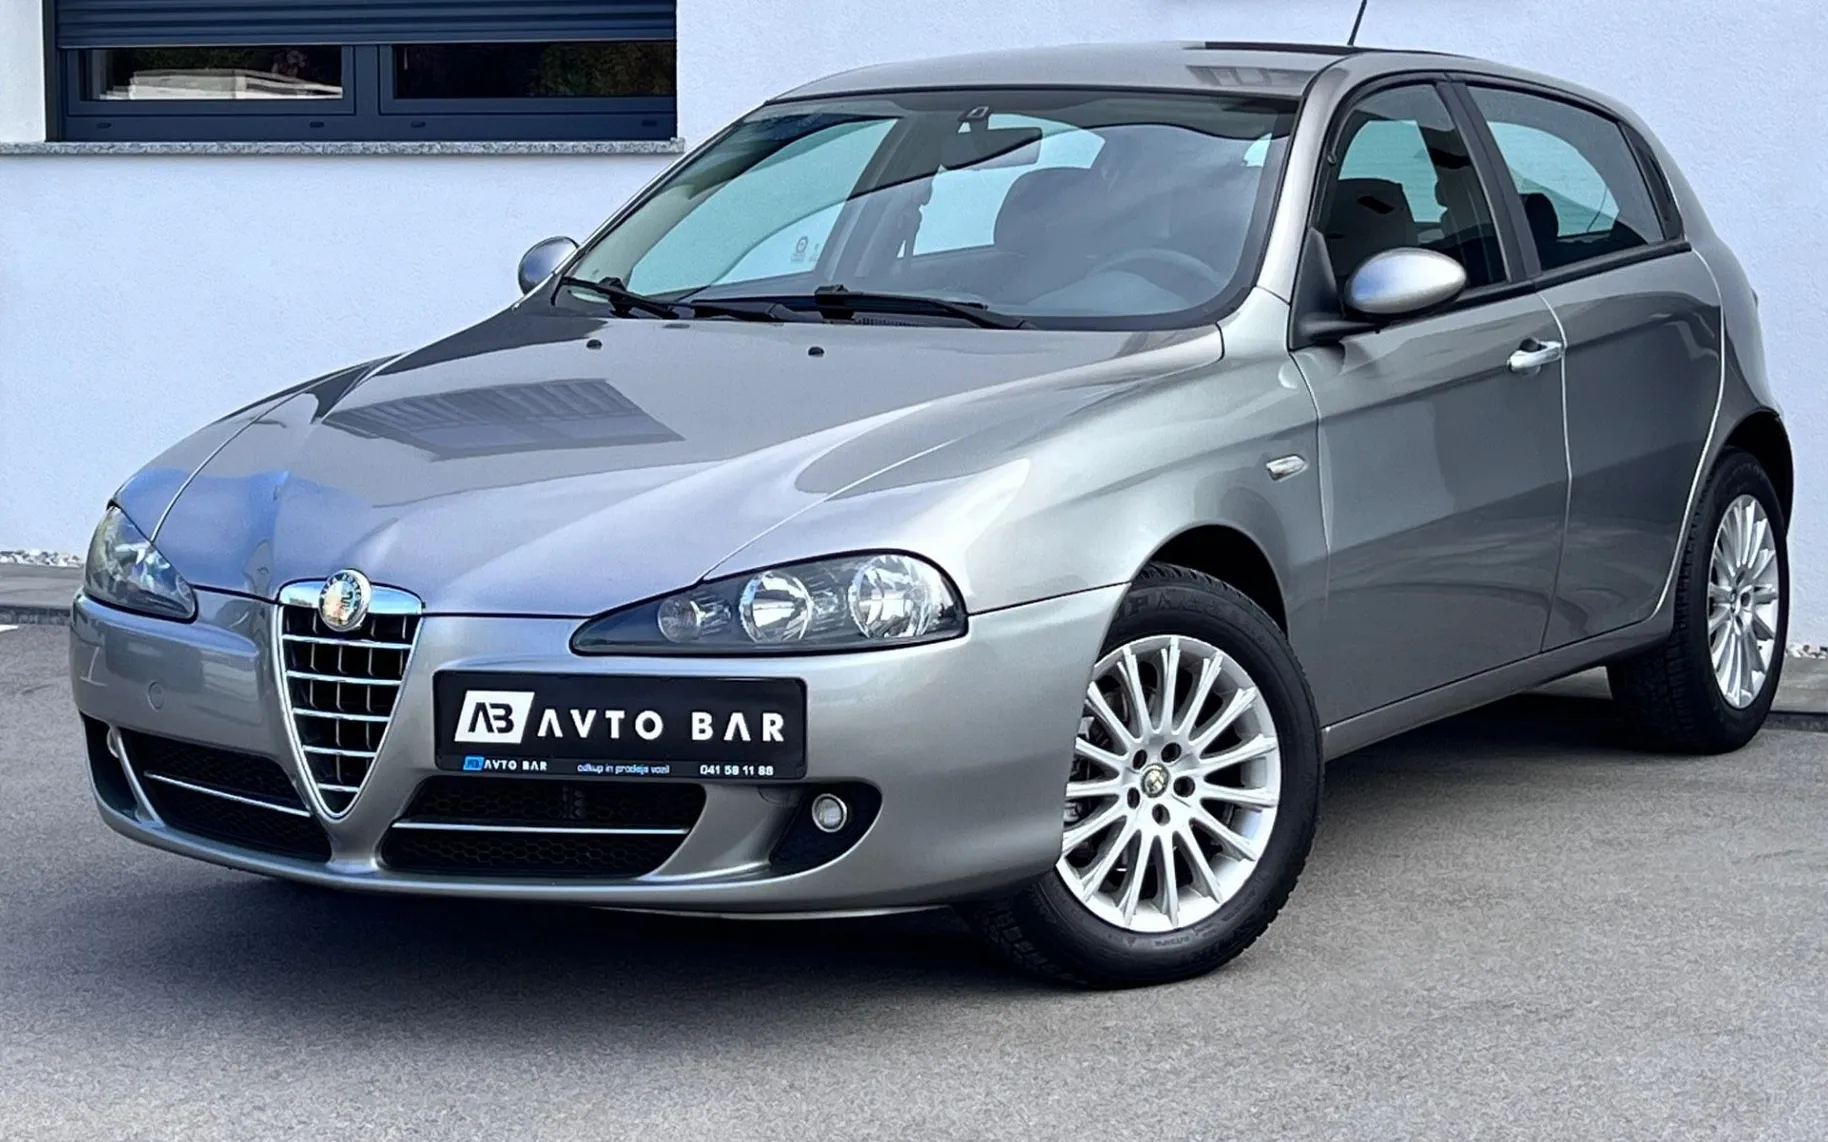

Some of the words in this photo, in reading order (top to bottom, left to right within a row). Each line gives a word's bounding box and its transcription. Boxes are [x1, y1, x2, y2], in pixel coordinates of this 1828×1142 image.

[537, 708, 663, 740] AVTO
[691, 711, 784, 742] BAR
[483, 759, 518, 771] AVTO
[522, 760, 548, 771] BAR
[605, 763, 614, 773] in
[700, 764, 720, 775] 041
[742, 765, 754, 776] 11
